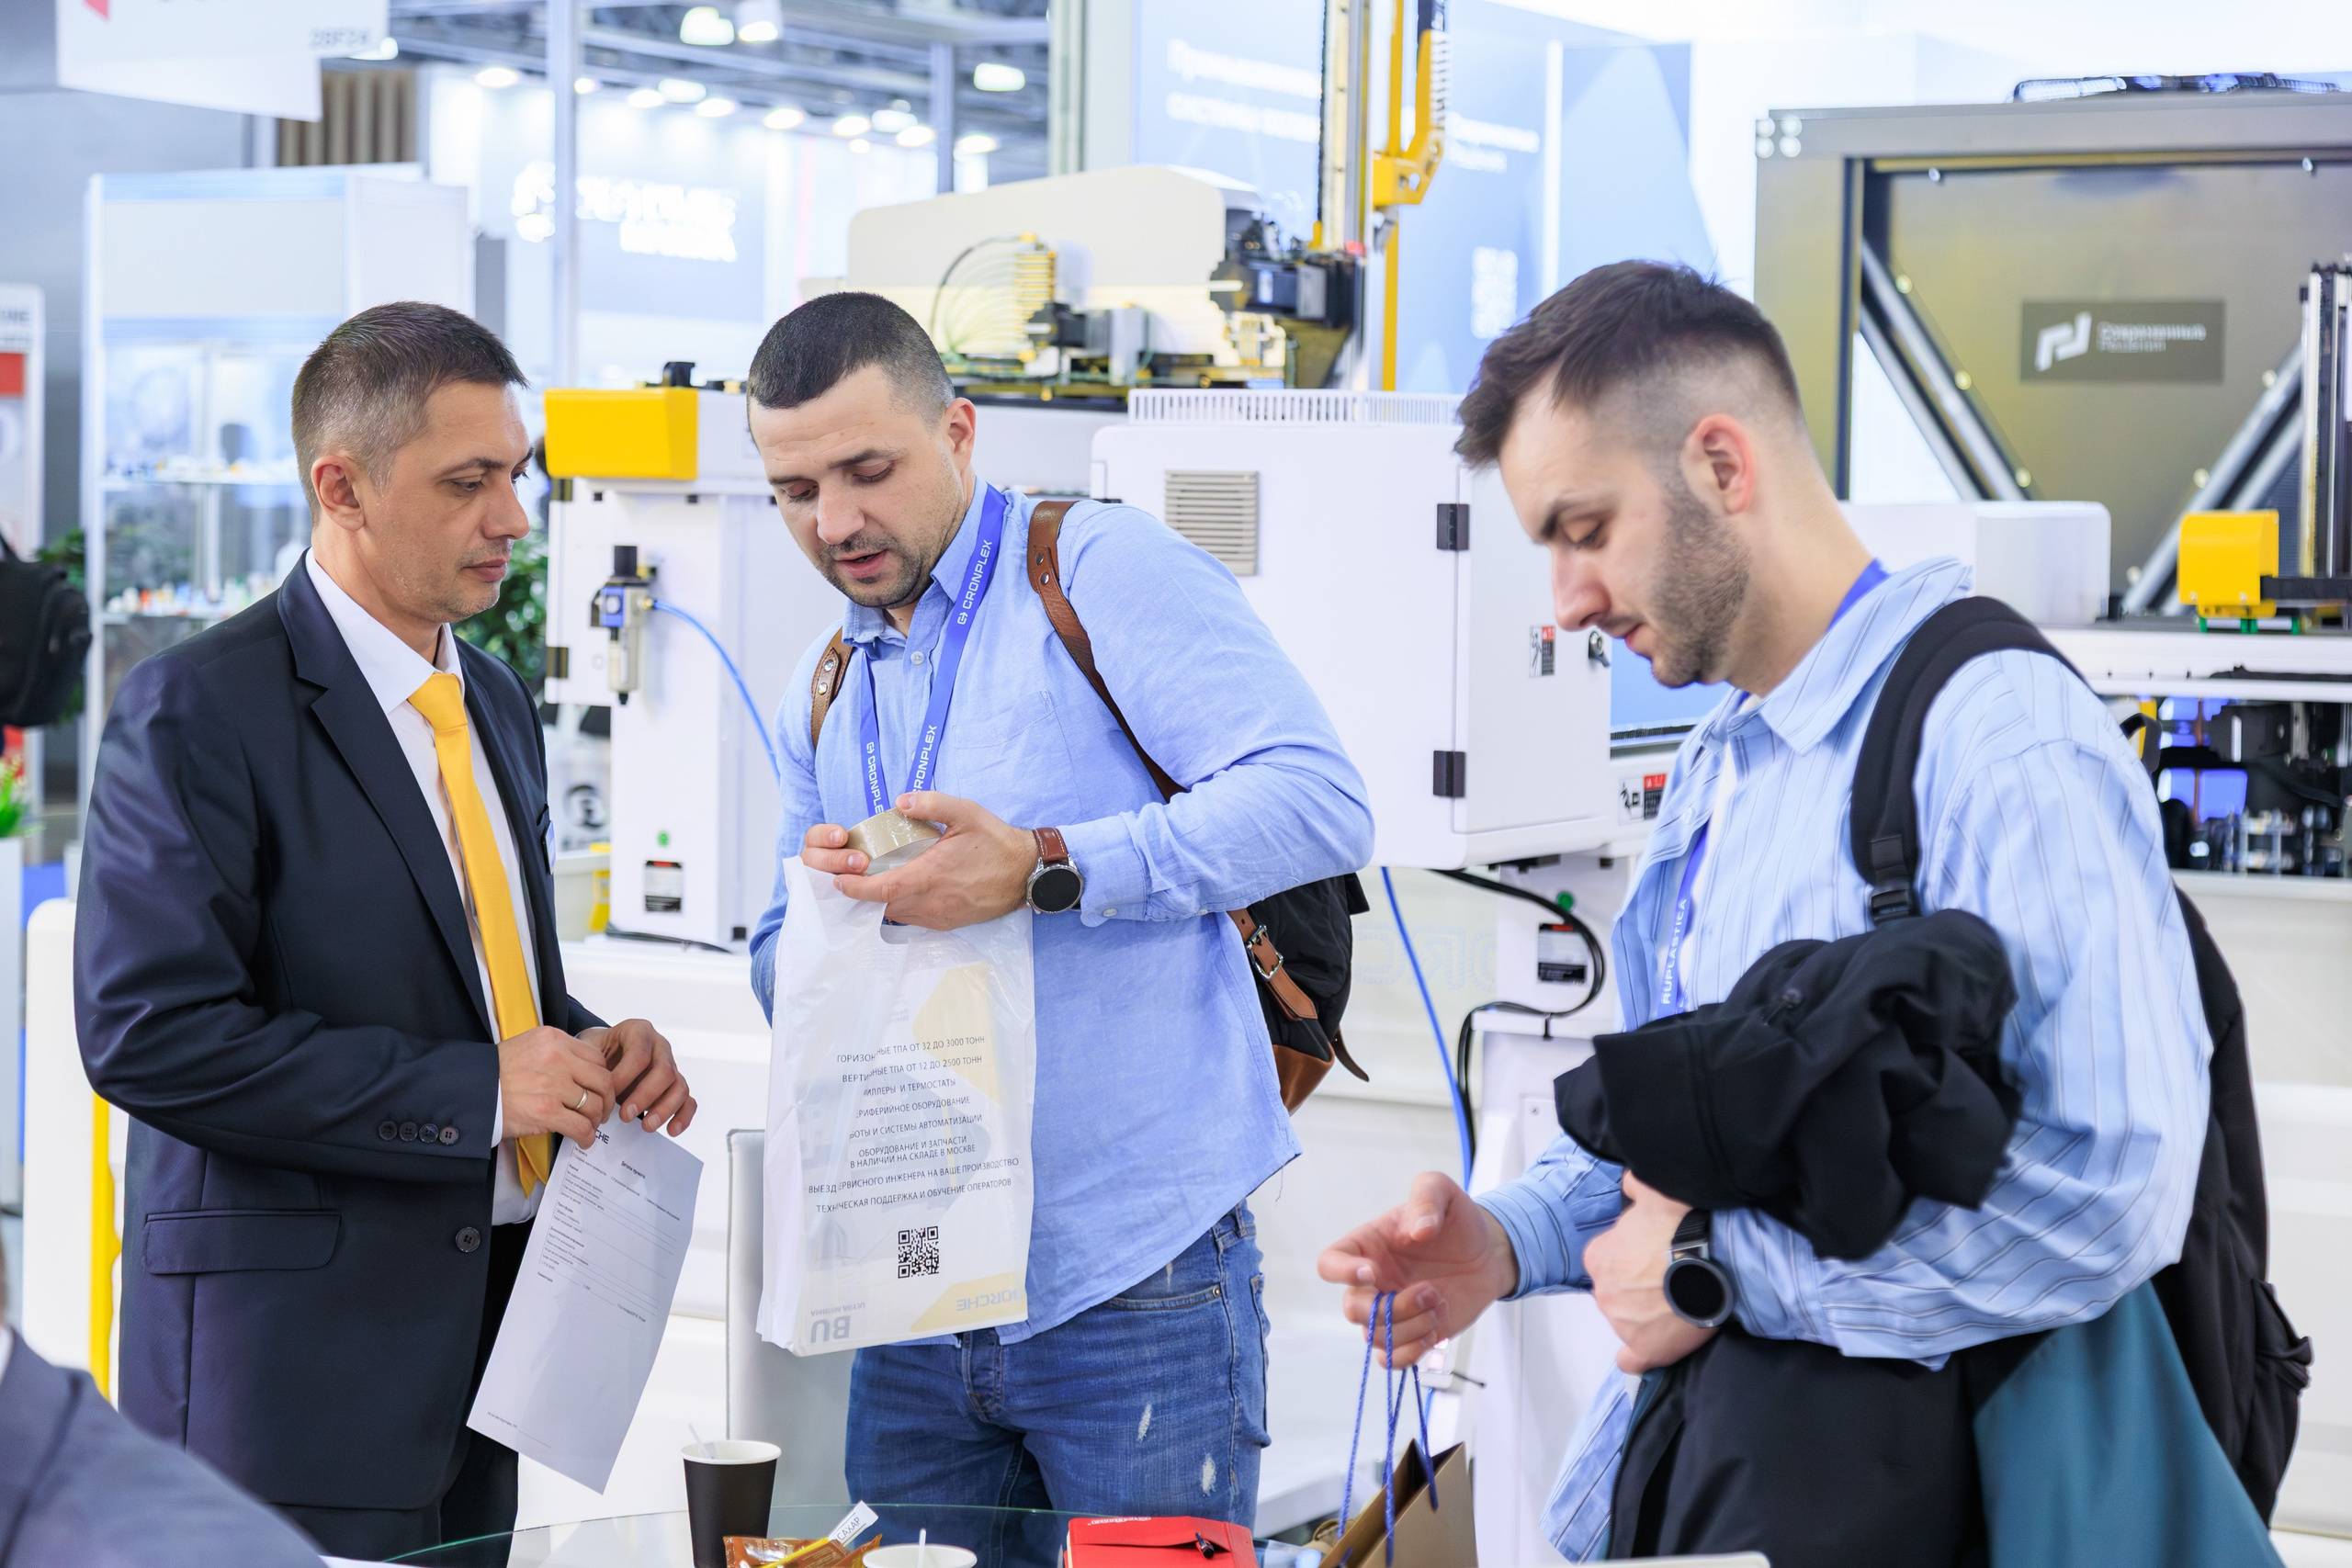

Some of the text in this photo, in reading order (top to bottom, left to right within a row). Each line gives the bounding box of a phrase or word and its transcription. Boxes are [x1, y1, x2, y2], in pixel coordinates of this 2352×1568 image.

[961, 539, 993, 610] CRONPLEX
[867, 755, 885, 815] CRONPLE
[1661, 898, 1688, 1005] RUPLASTICA
[893, 1043, 909, 1054] ТПА
[909, 1043, 921, 1053] ОТ
[922, 1041, 932, 1051] 32
[933, 1040, 945, 1051] ДО
[946, 1037, 965, 1048] 3000
[965, 1035, 986, 1045] ТОНН
[889, 1064, 905, 1074] ТПА
[906, 1063, 917, 1073] ОТ
[919, 1061, 929, 1071] 12
[929, 1059, 942, 1071] ДО
[943, 1057, 962, 1068] 2500
[962, 1055, 983, 1066] ТОНН
[899, 1083, 907, 1092] И
[907, 1077, 956, 1092] ТЕРМОСТАТЫ
[855, 1095, 971, 1120] РИФЕРИЙНОЕ ОБОРУДОВАНИЕ
[872, 1126, 879, 1136] И
[879, 1122, 918, 1135] СИСТЕМЫ
[918, 1113, 983, 1130] АВТОМАТИЗАЦИИ
[850, 1144, 976, 1169] В НАЛИЧИИ НА СКЛАДЕ В МОСКВЕ
[858, 1135, 967, 1158] ОБОРУДОВАНИЕ И ЗАПЧАСТИ
[808, 1184, 837, 1194] ВЫЕЗД
[885, 1170, 926, 1184] ИНЖЕНЕРА
[927, 1168, 939, 1178] НА
[940, 1165, 961, 1177] ВАШЕ
[961, 1157, 1020, 1175] ПРОИЗВОДСТВО
[870, 1191, 918, 1205] ПОДДЕРЖКА
[919, 1190, 926, 1200] И
[926, 1184, 967, 1198] ОБУЧЕНИЕ
[967, 1178, 1012, 1193] ОПЕРАТОРОВ
[810, 1314, 852, 1344] BU
[837, 1517, 861, 1541] САХАР
